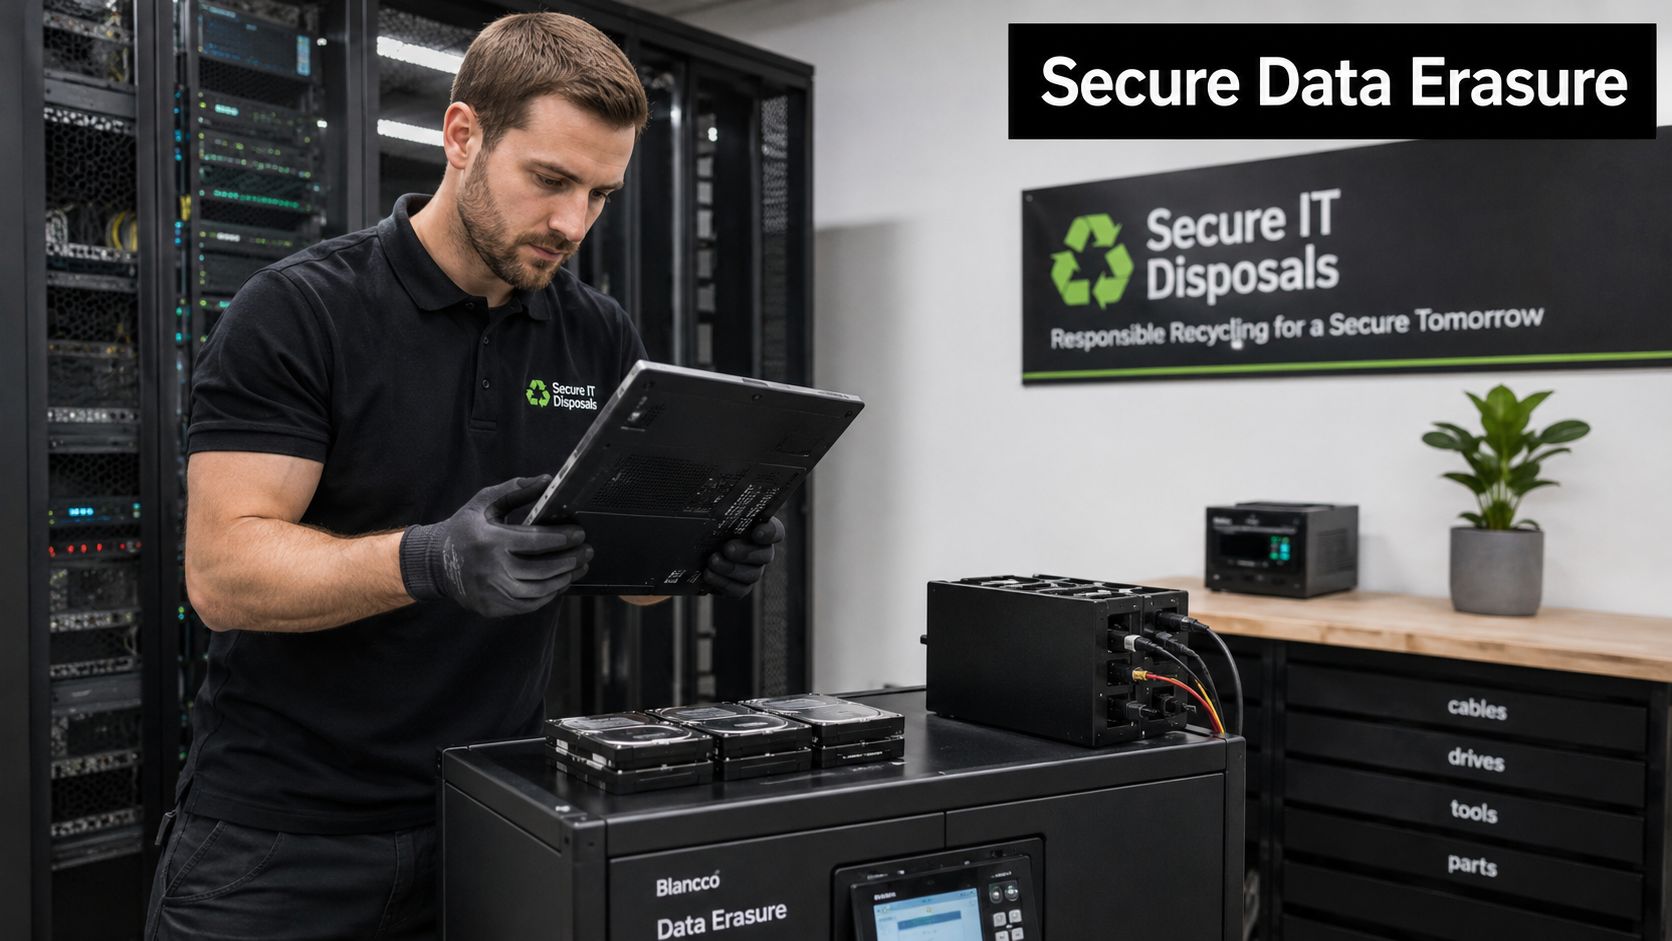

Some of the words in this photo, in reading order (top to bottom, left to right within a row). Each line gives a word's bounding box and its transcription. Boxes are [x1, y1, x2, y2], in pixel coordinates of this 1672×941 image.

[1146, 206, 1287, 252] Secure
[1299, 188, 1342, 238] IT
[1147, 244, 1340, 305] Disposals
[1050, 322, 1166, 352] Responsible
[1169, 317, 1270, 346] Recycling
[1273, 314, 1306, 339] for
[1309, 318, 1325, 338] a
[1328, 312, 1411, 337] Secure
[1414, 307, 1545, 332] Tomorrow
[552, 381, 586, 397] Secure
[586, 384, 597, 397] IT
[553, 394, 598, 411] Disposals
[1447, 698, 1508, 721] cables
[1447, 747, 1505, 772] drives
[1450, 799, 1498, 824] tools
[1448, 855, 1498, 878] parts
[656, 875, 720, 898] Blancco
[657, 915, 707, 941] Data
[711, 903, 788, 931] Erasure
